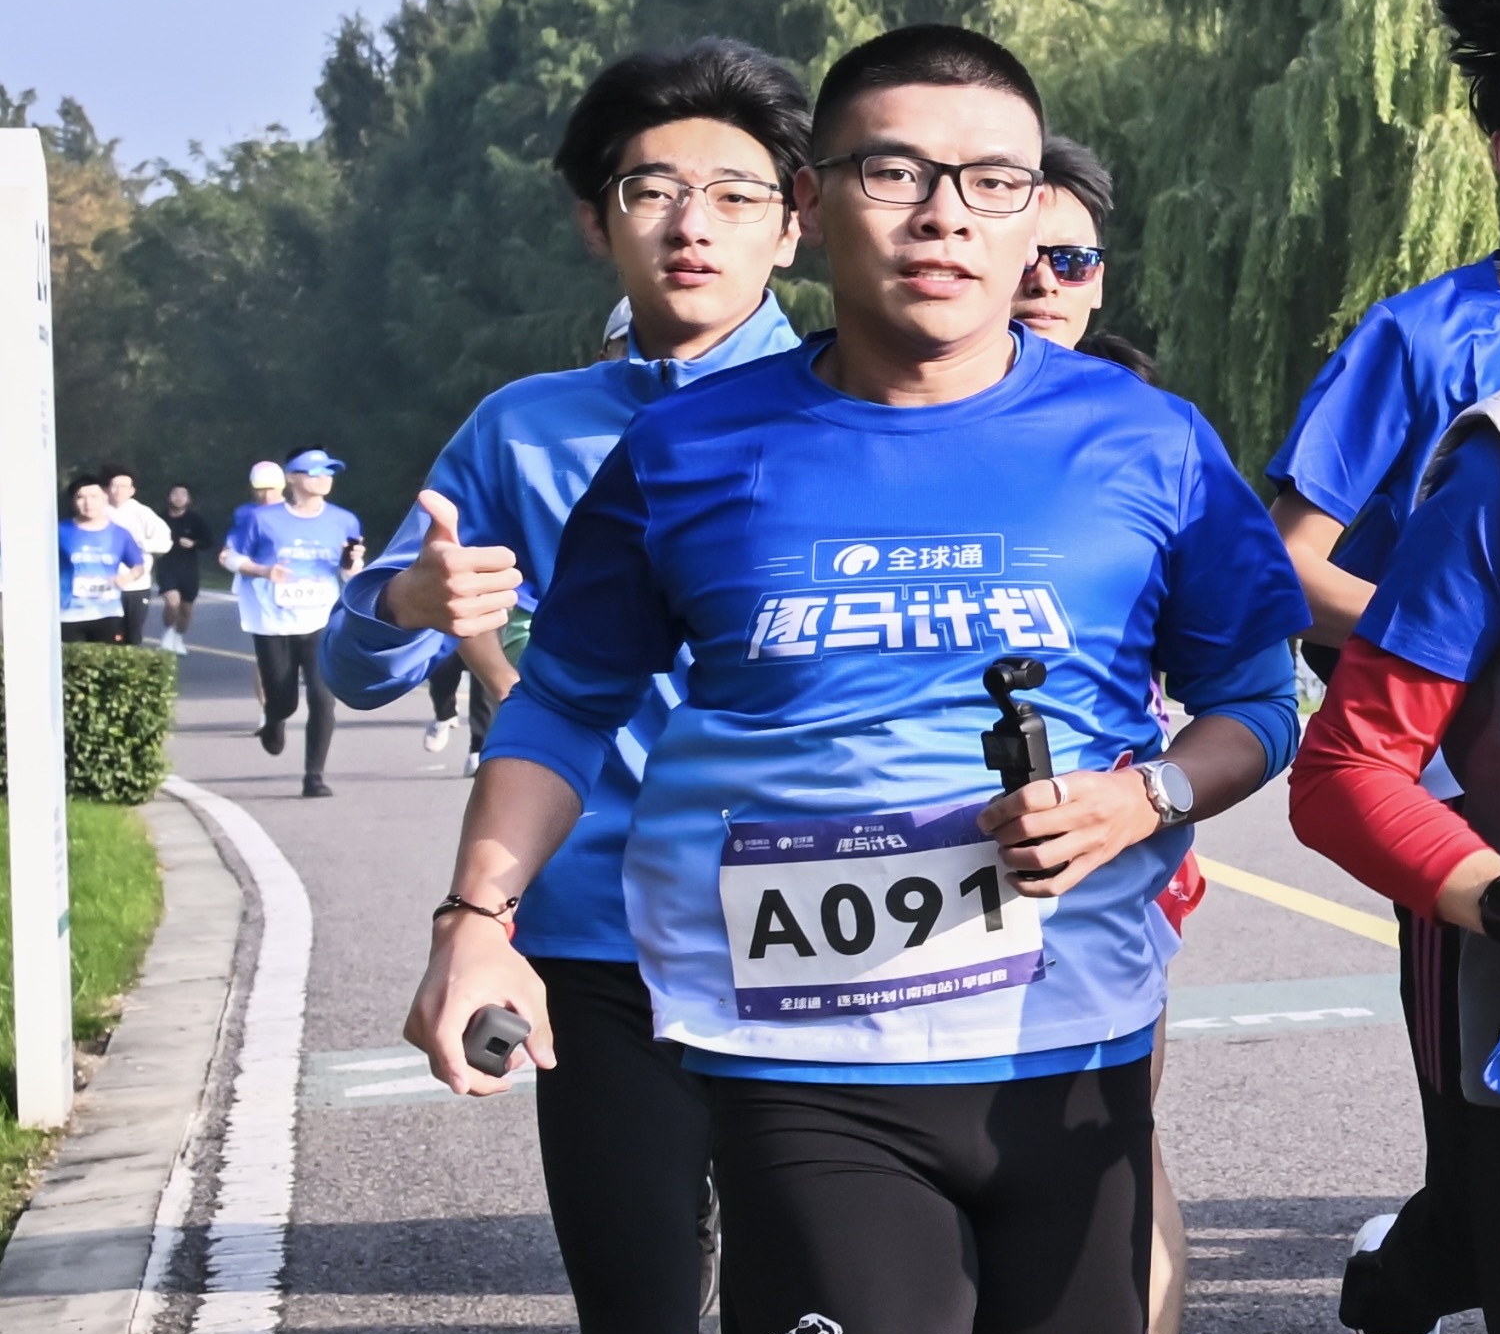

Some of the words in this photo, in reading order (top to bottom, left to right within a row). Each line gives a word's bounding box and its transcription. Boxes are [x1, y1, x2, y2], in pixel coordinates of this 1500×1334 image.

[887, 544, 983, 571] 全球通
[748, 588, 1070, 660] 逐马计划
[836, 834, 907, 853] 逐马计划
[749, 865, 1003, 959] A091
